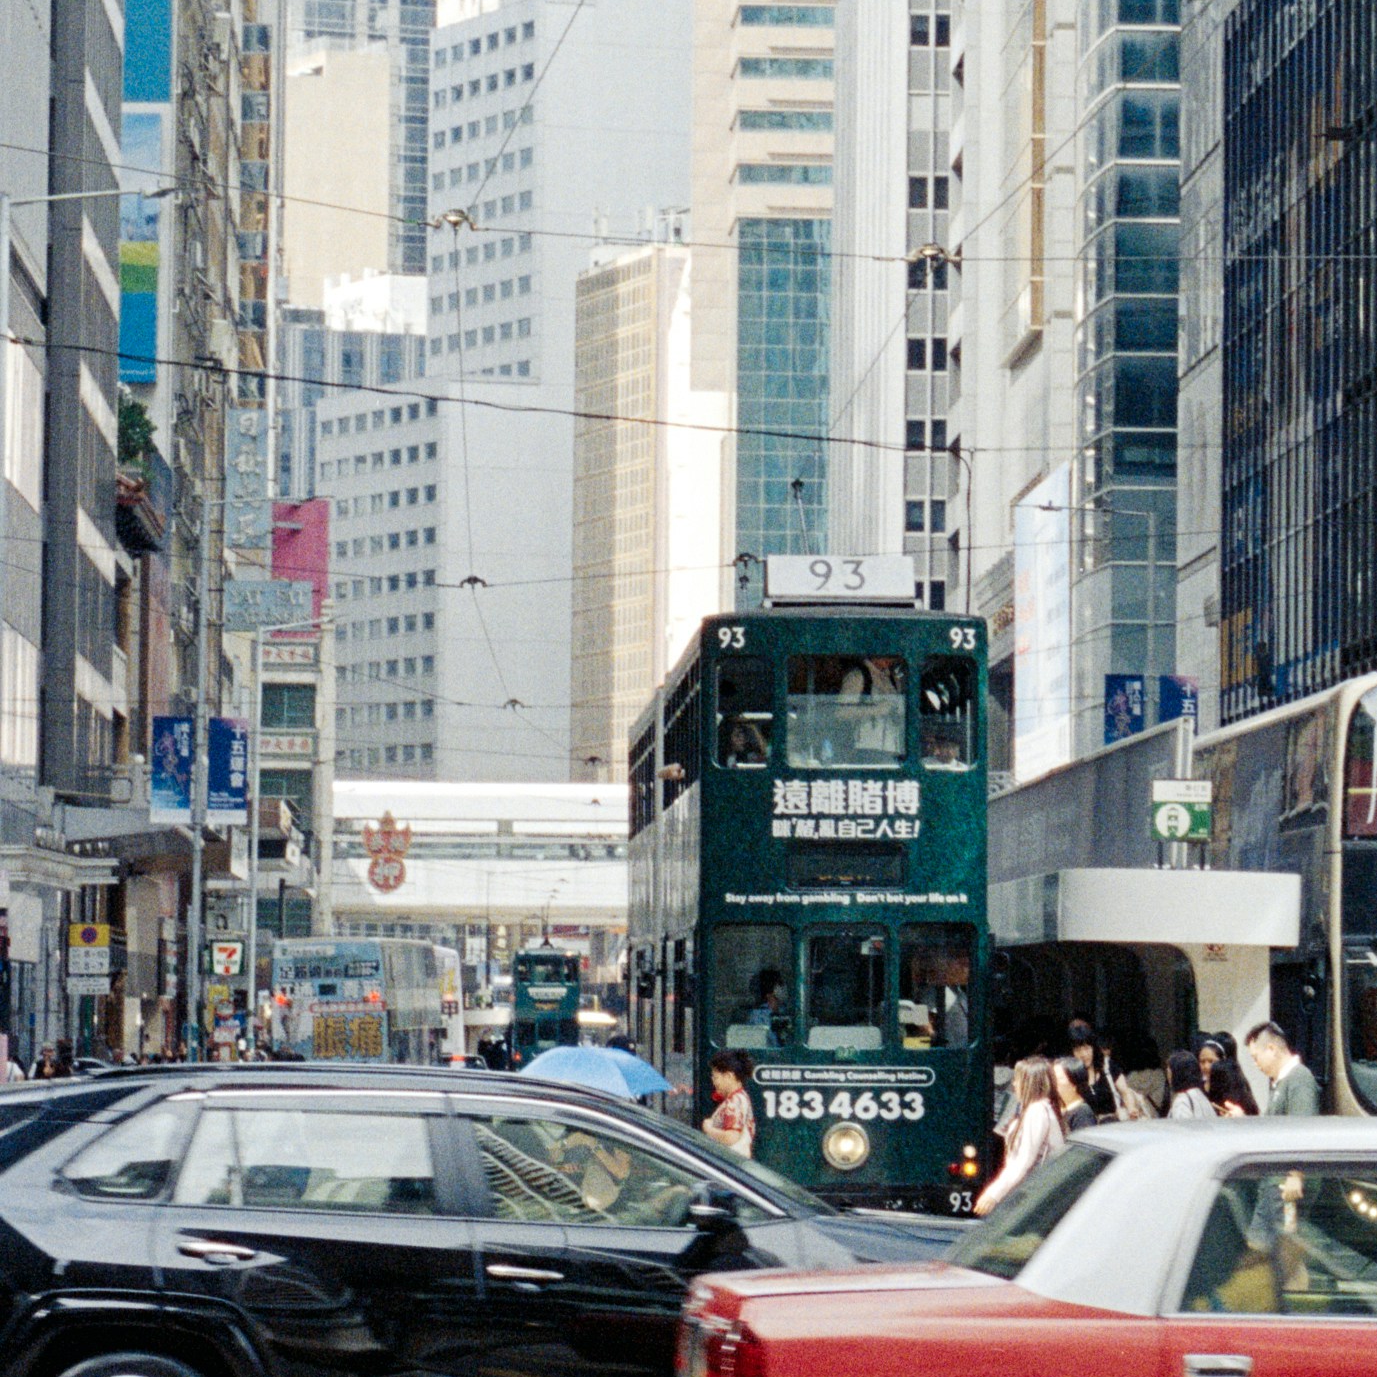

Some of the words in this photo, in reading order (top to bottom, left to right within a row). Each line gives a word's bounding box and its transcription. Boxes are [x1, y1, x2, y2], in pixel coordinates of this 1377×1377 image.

[809, 559, 867, 591] 93
[718, 627, 745, 649] 93
[949, 627, 977, 649] 93
[773, 779, 920, 815] 遠離賭博
[725, 892, 747, 905] Stay
[748, 895, 775, 905] away
[776, 892, 800, 903] from
[802, 892, 850, 905] gambling
[856, 893, 885, 903] Don't
[886, 893, 904, 903] bet
[904, 895, 927, 905] your
[929, 893, 944, 903] life
[945, 895, 958, 903] on
[959, 893, 968, 903] it
[804, 1070, 846, 1082] Gambling
[847, 1071, 896, 1082] Counselling
[949, 1191, 973, 1213] 93
